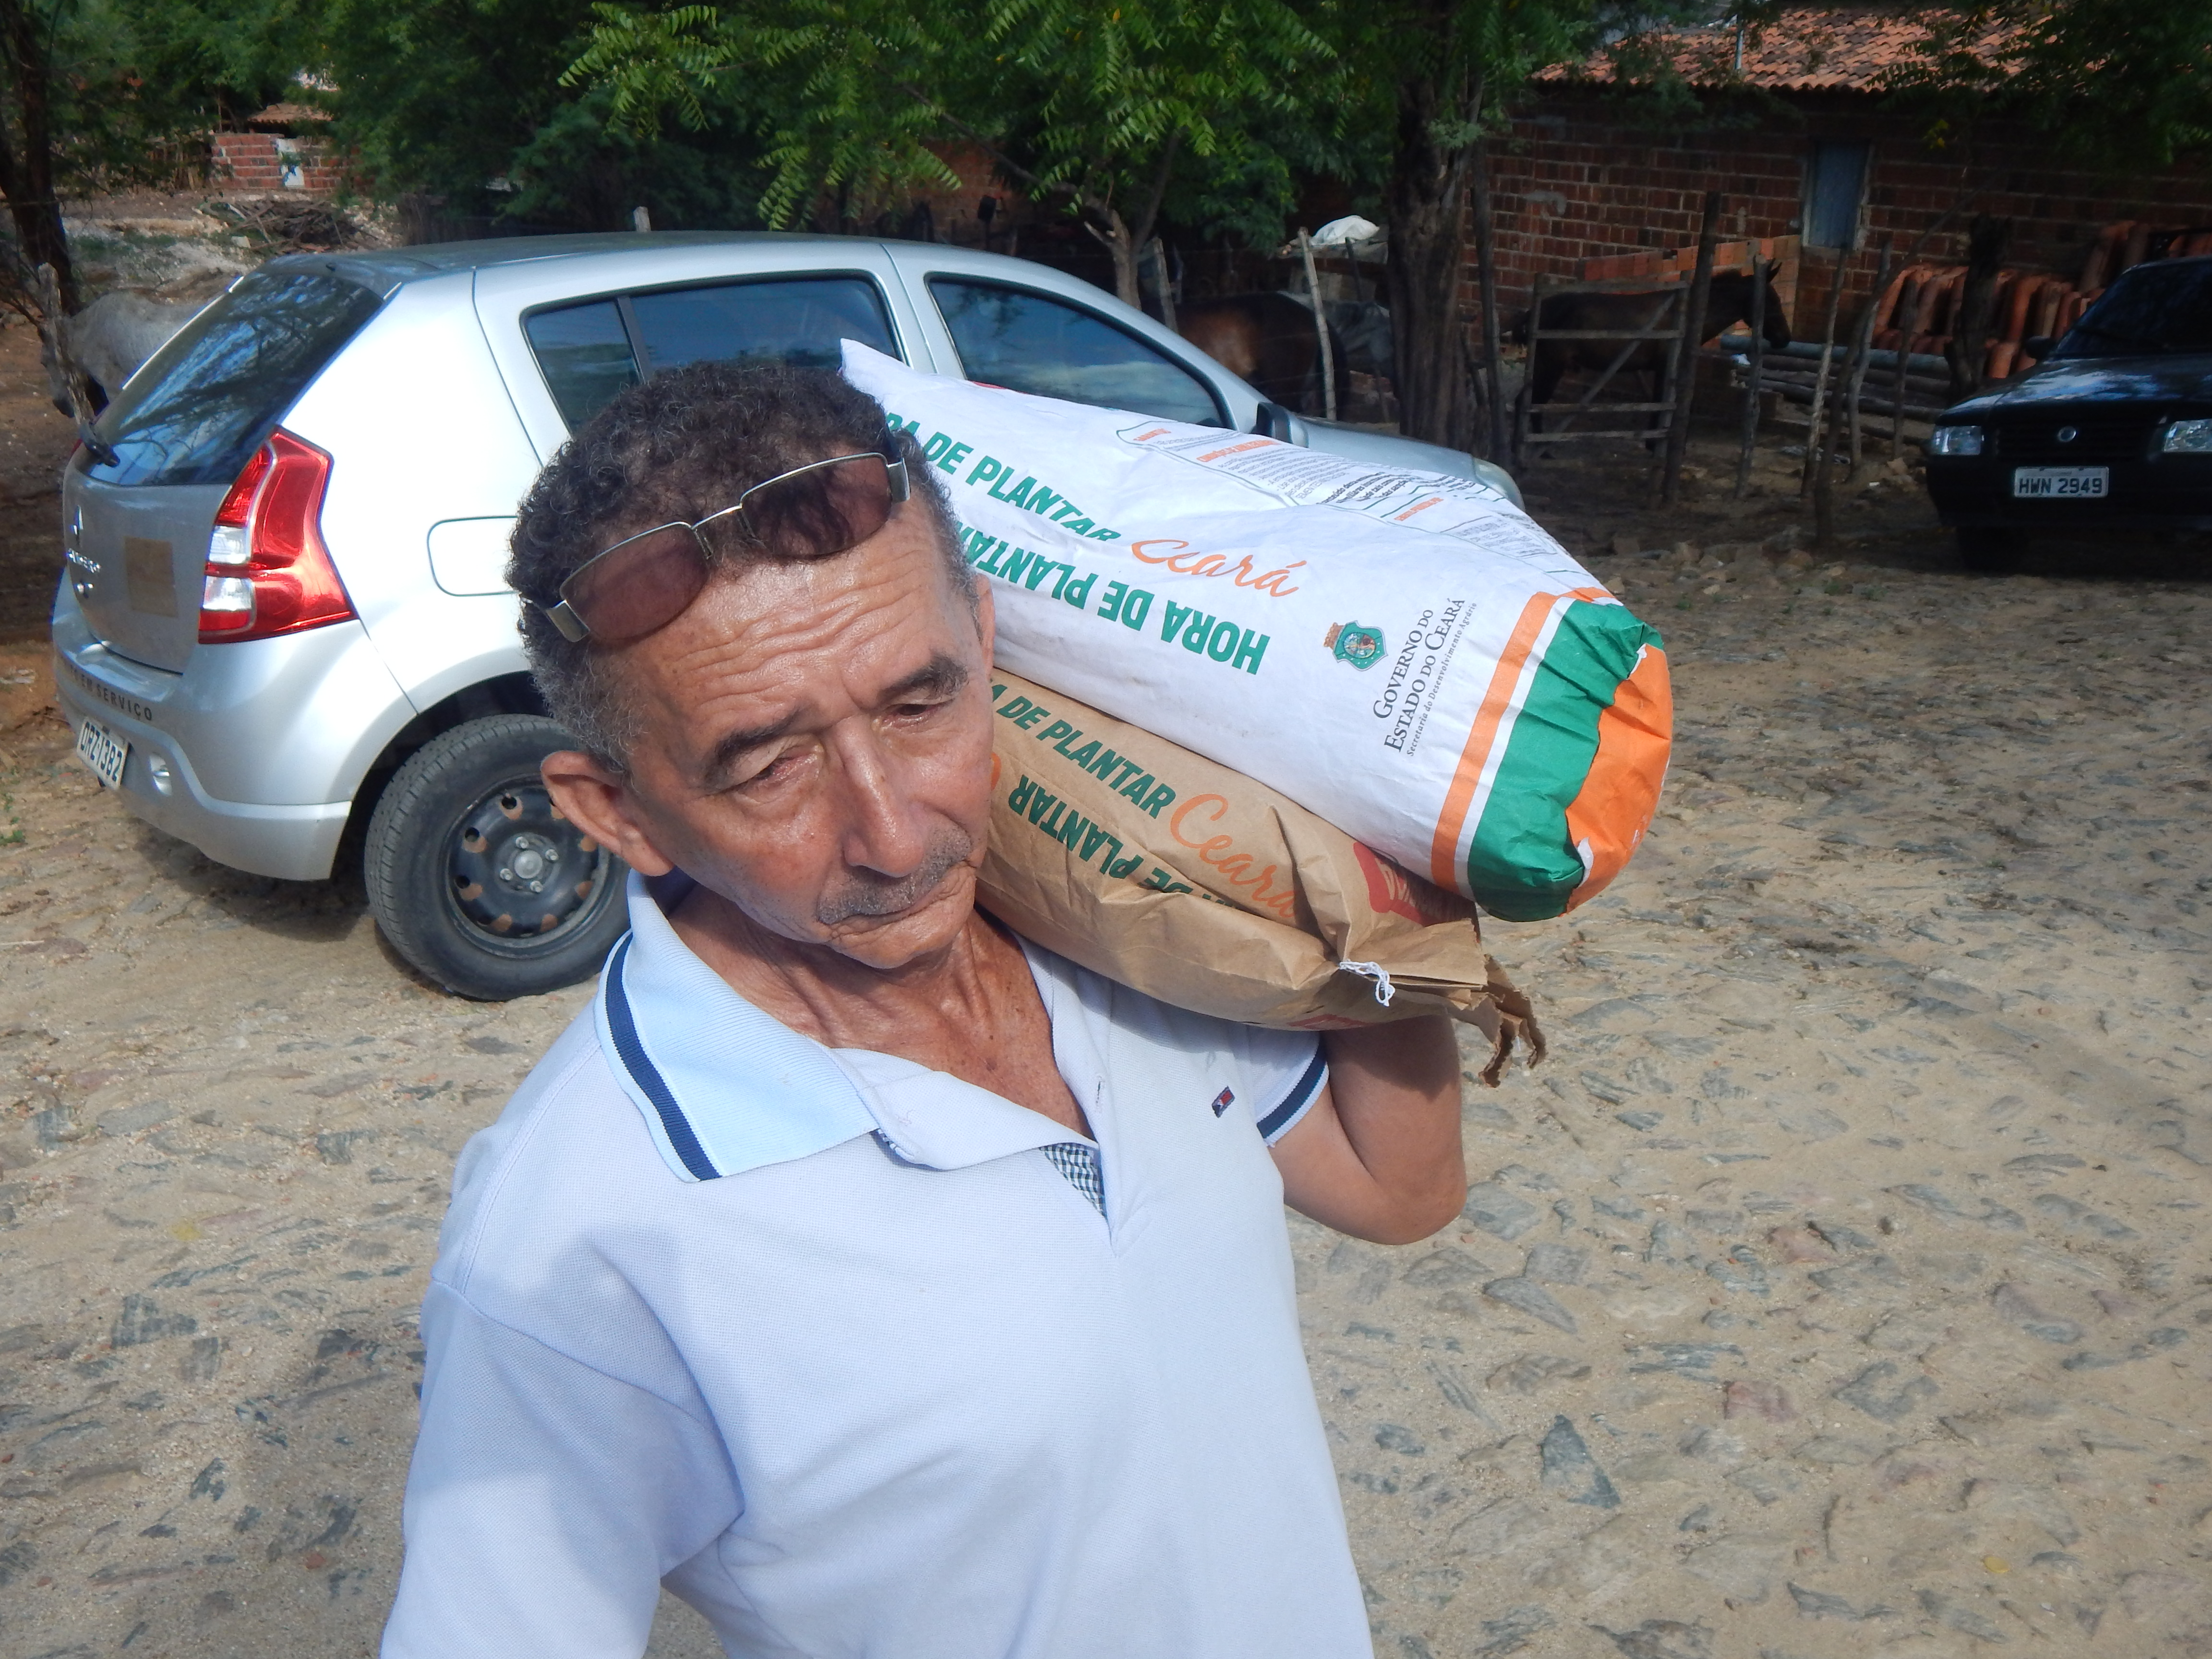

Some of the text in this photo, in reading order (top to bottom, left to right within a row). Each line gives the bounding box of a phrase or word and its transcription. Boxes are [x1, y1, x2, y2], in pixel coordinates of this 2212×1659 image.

[922, 432, 1122, 541] DE PLANTAR
[2019, 478, 2103, 493] HWN 2949
[1097, 581, 1155, 631] DE
[1131, 539, 1307, 597] Ceará
[1160, 600, 1271, 675] HORA
[1373, 609, 1434, 719] GOVERNO DO
[1384, 598, 1466, 753] ESTADO DO CEARÁ
[1407, 602, 1478, 757] Secretaria do Desenvolvimento Agrário
[996, 696, 1177, 819] DE PLANTAR
[1008, 774, 1145, 879] PLANTAR
